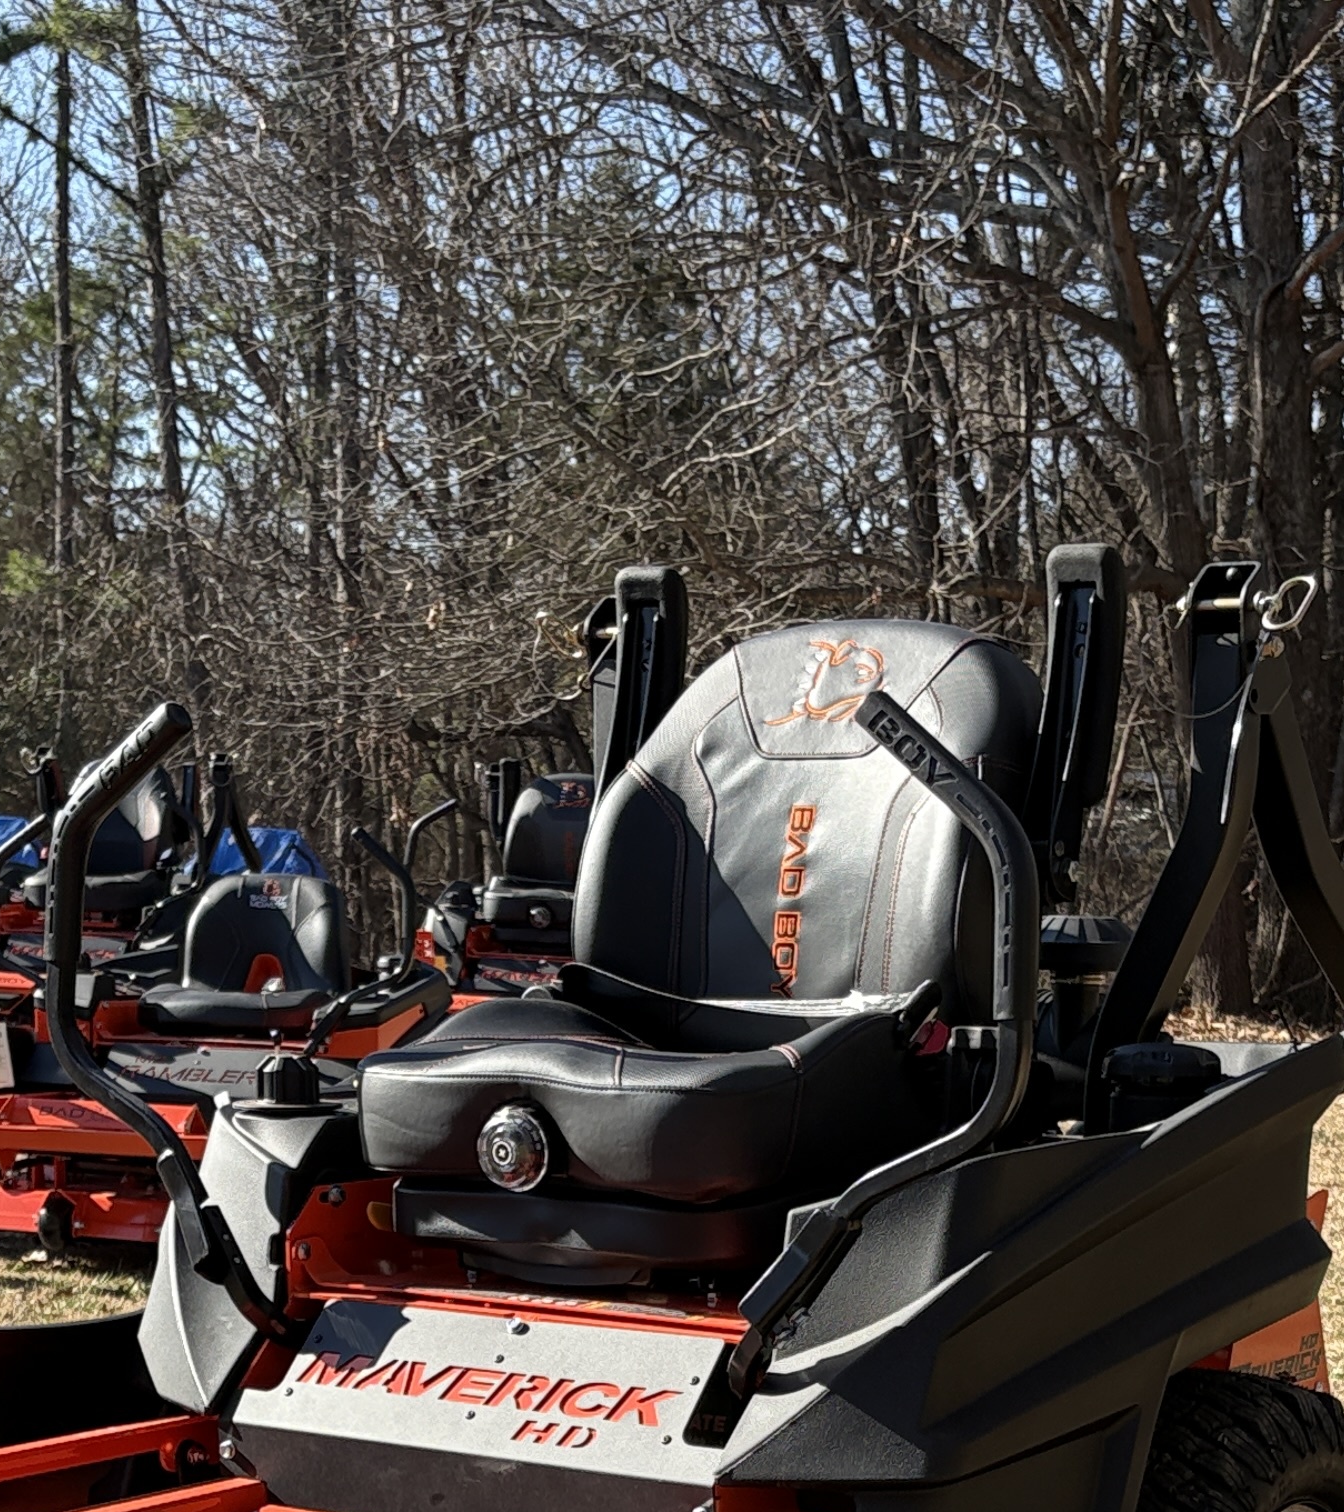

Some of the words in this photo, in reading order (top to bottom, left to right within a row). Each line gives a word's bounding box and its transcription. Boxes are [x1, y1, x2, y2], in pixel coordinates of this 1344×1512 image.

[867, 709, 956, 786] BOY
[779, 804, 817, 899] BAD
[770, 911, 802, 999] BOY
[297, 1350, 684, 1427] MAVERICK
[510, 1420, 598, 1449] HD
